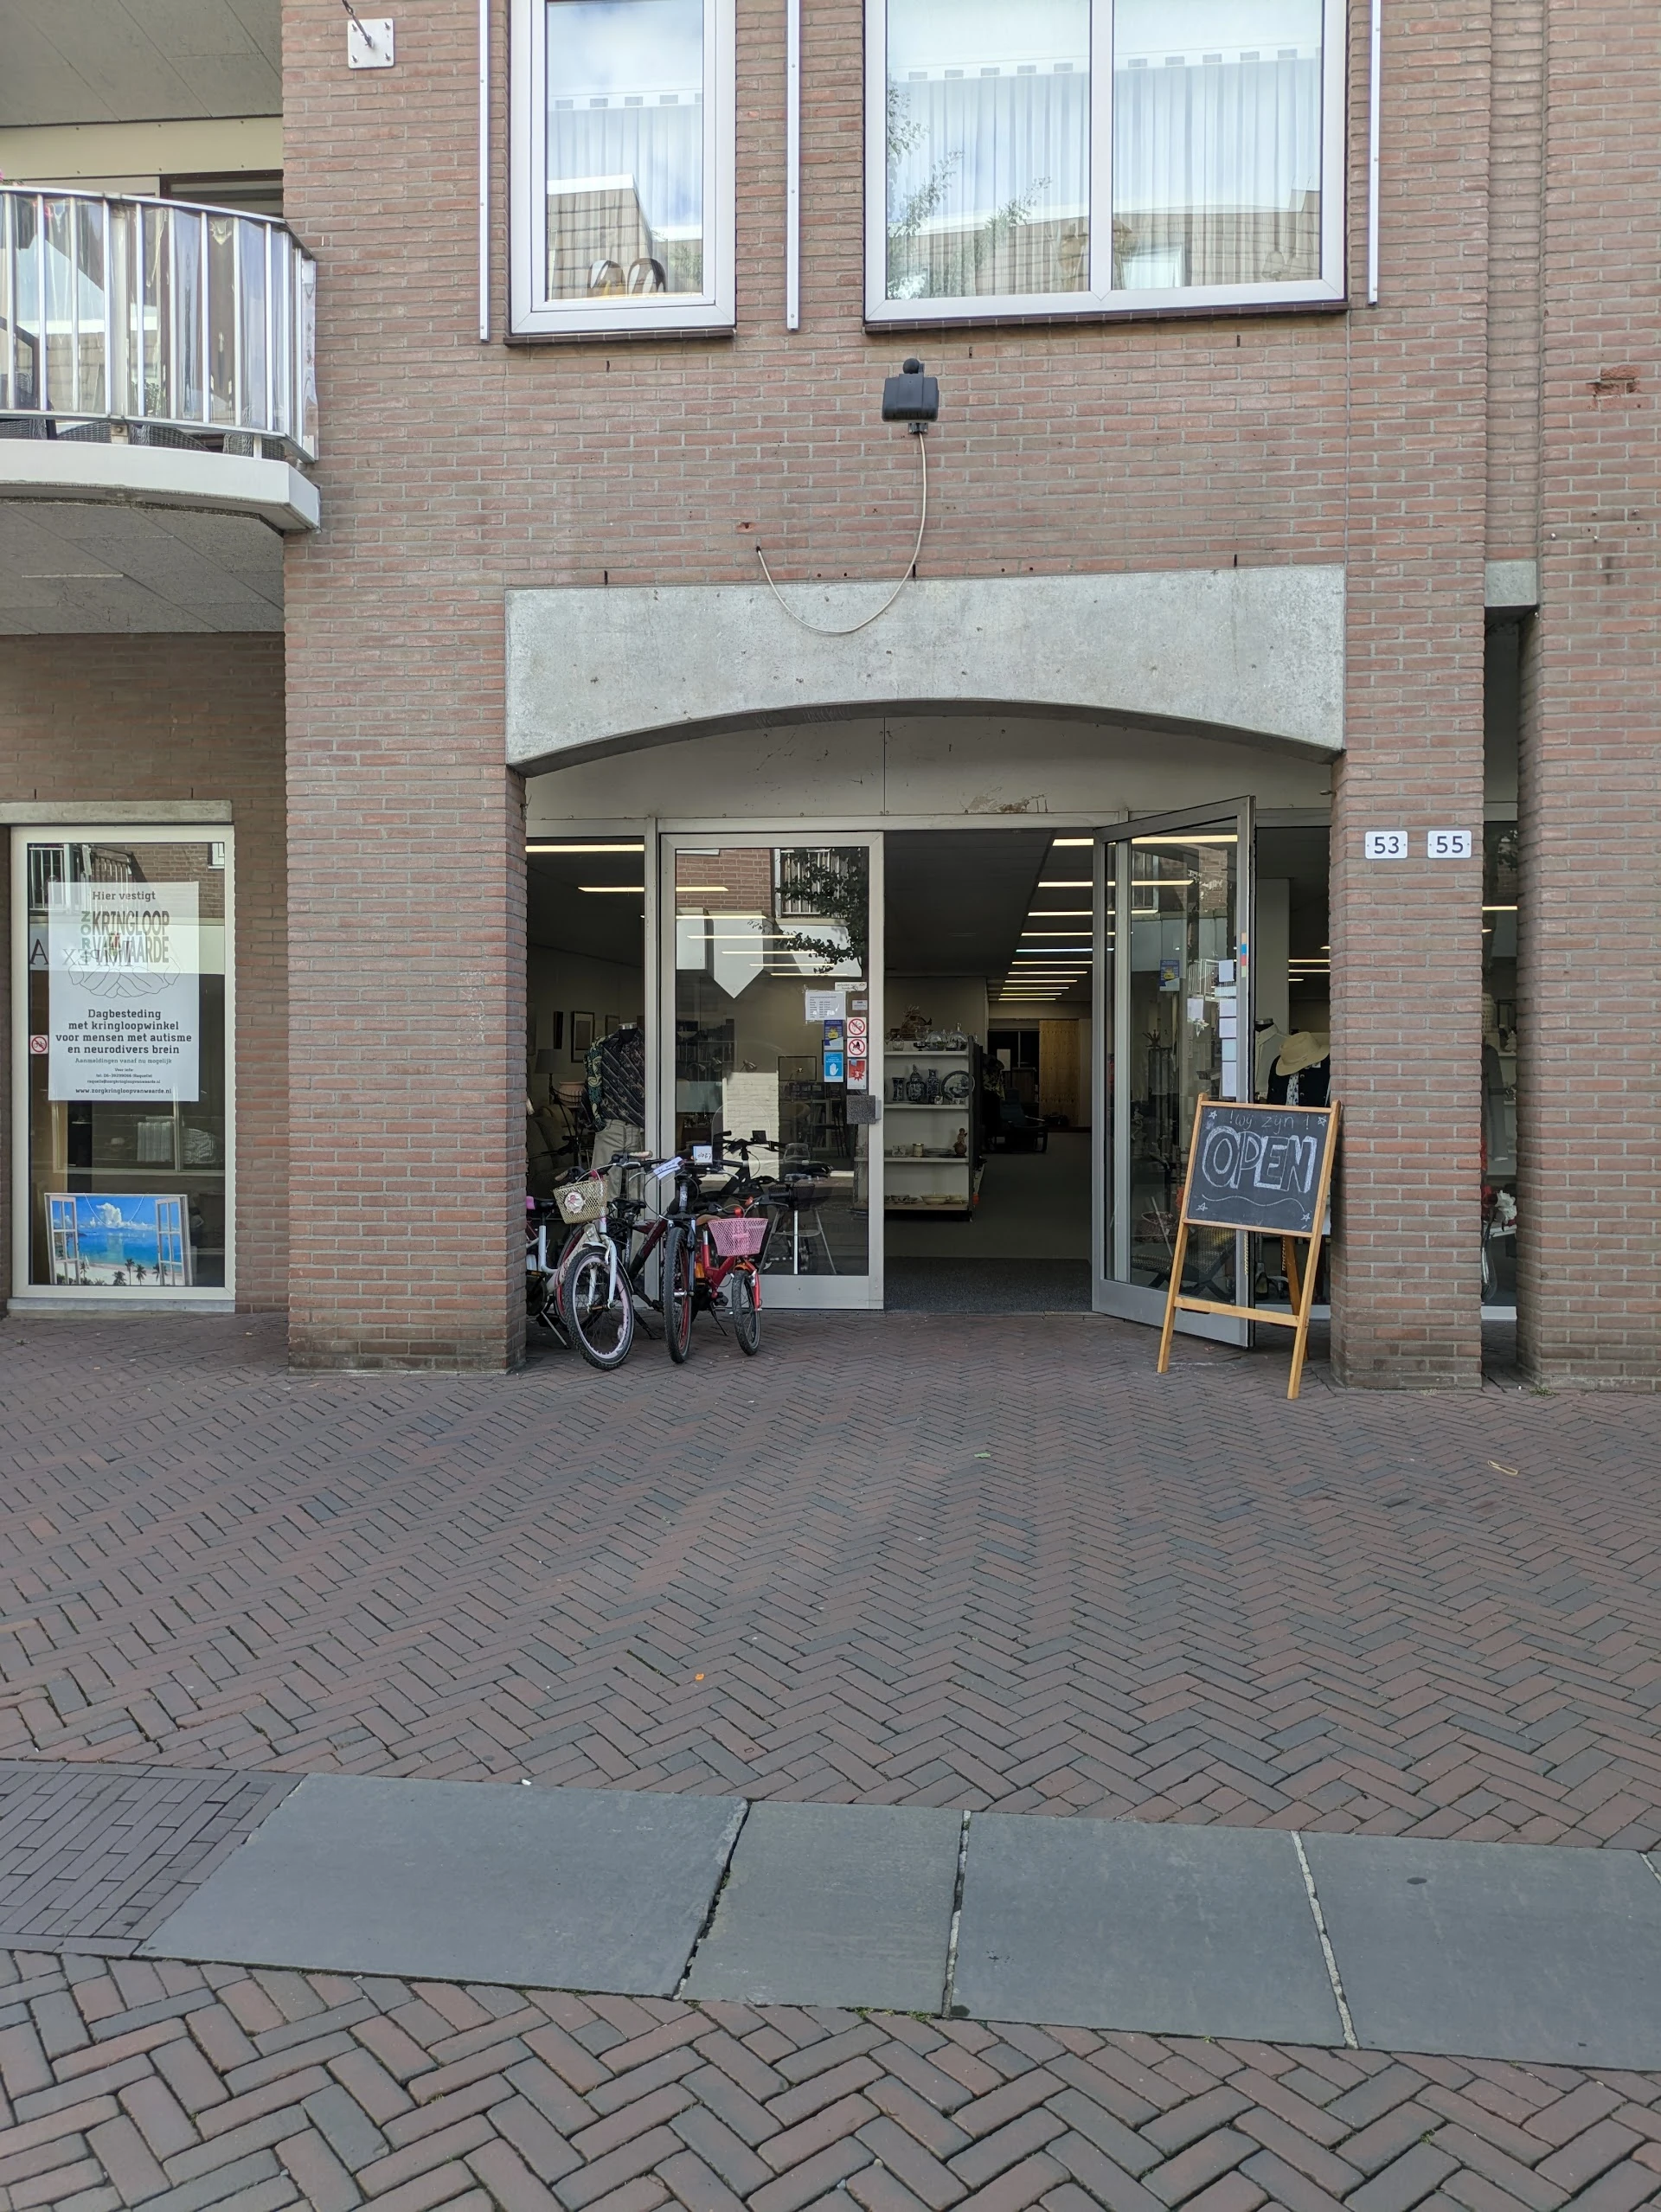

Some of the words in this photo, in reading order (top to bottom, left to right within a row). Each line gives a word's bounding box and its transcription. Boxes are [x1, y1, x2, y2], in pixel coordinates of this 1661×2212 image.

[1374, 836, 1400, 854] 53
[1436, 835, 1464, 854] 55
[93, 891, 116, 901] Hier
[119, 891, 157, 904] vestigt
[92, 910, 170, 935] KRINGLOOP
[87, 1009, 162, 1020] Dagbesteding
[68, 1022, 88, 1030] met
[91, 1021, 179, 1032] kringloopwinkel
[127, 1034, 147, 1042] met
[151, 1033, 192, 1042] autisme
[84, 1044, 149, 1054] neurodivers
[152, 1044, 180, 1054] brein
[1202, 1125, 1318, 1194] OPEN
